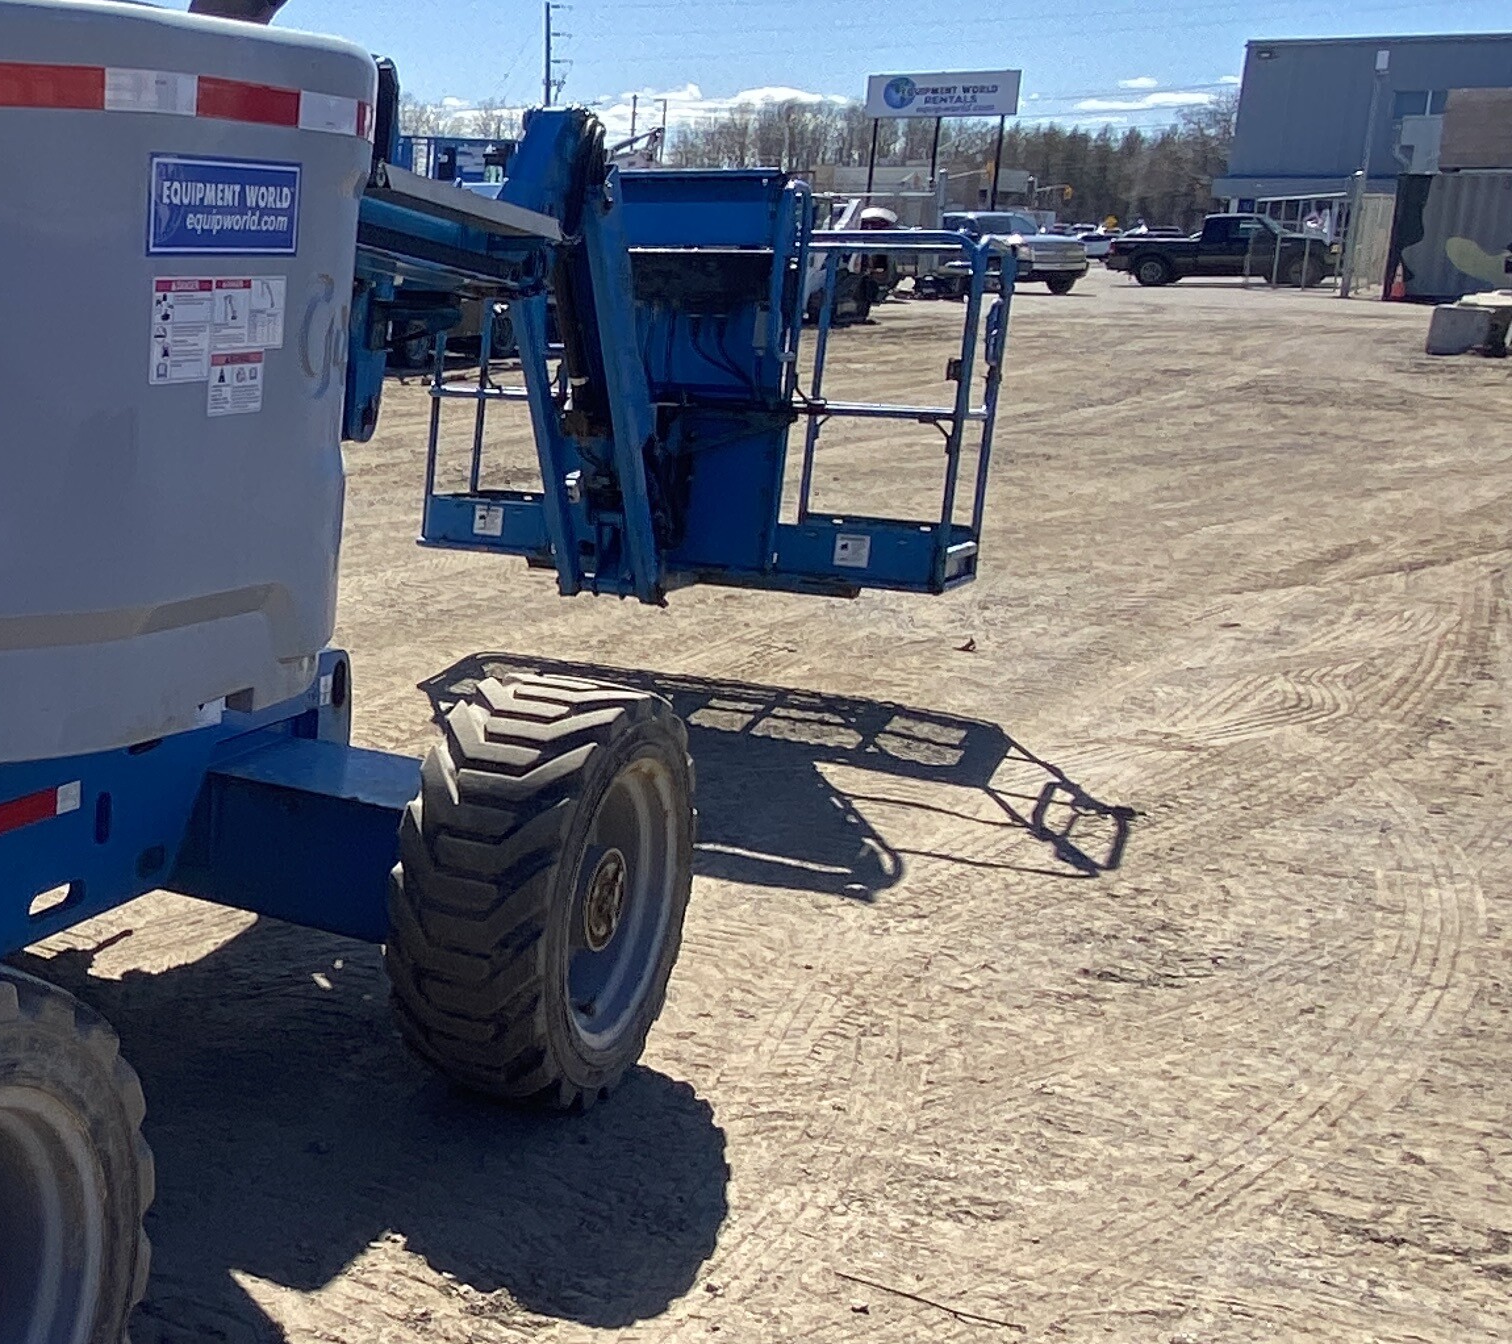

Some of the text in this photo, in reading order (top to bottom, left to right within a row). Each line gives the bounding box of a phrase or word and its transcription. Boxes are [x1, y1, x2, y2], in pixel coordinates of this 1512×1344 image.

[962, 84, 999, 94] WORLD
[924, 94, 978, 105] RENTALS
[161, 181, 292, 209] EQUIPMENT WORLD
[186, 208, 289, 235] equipworld.com
